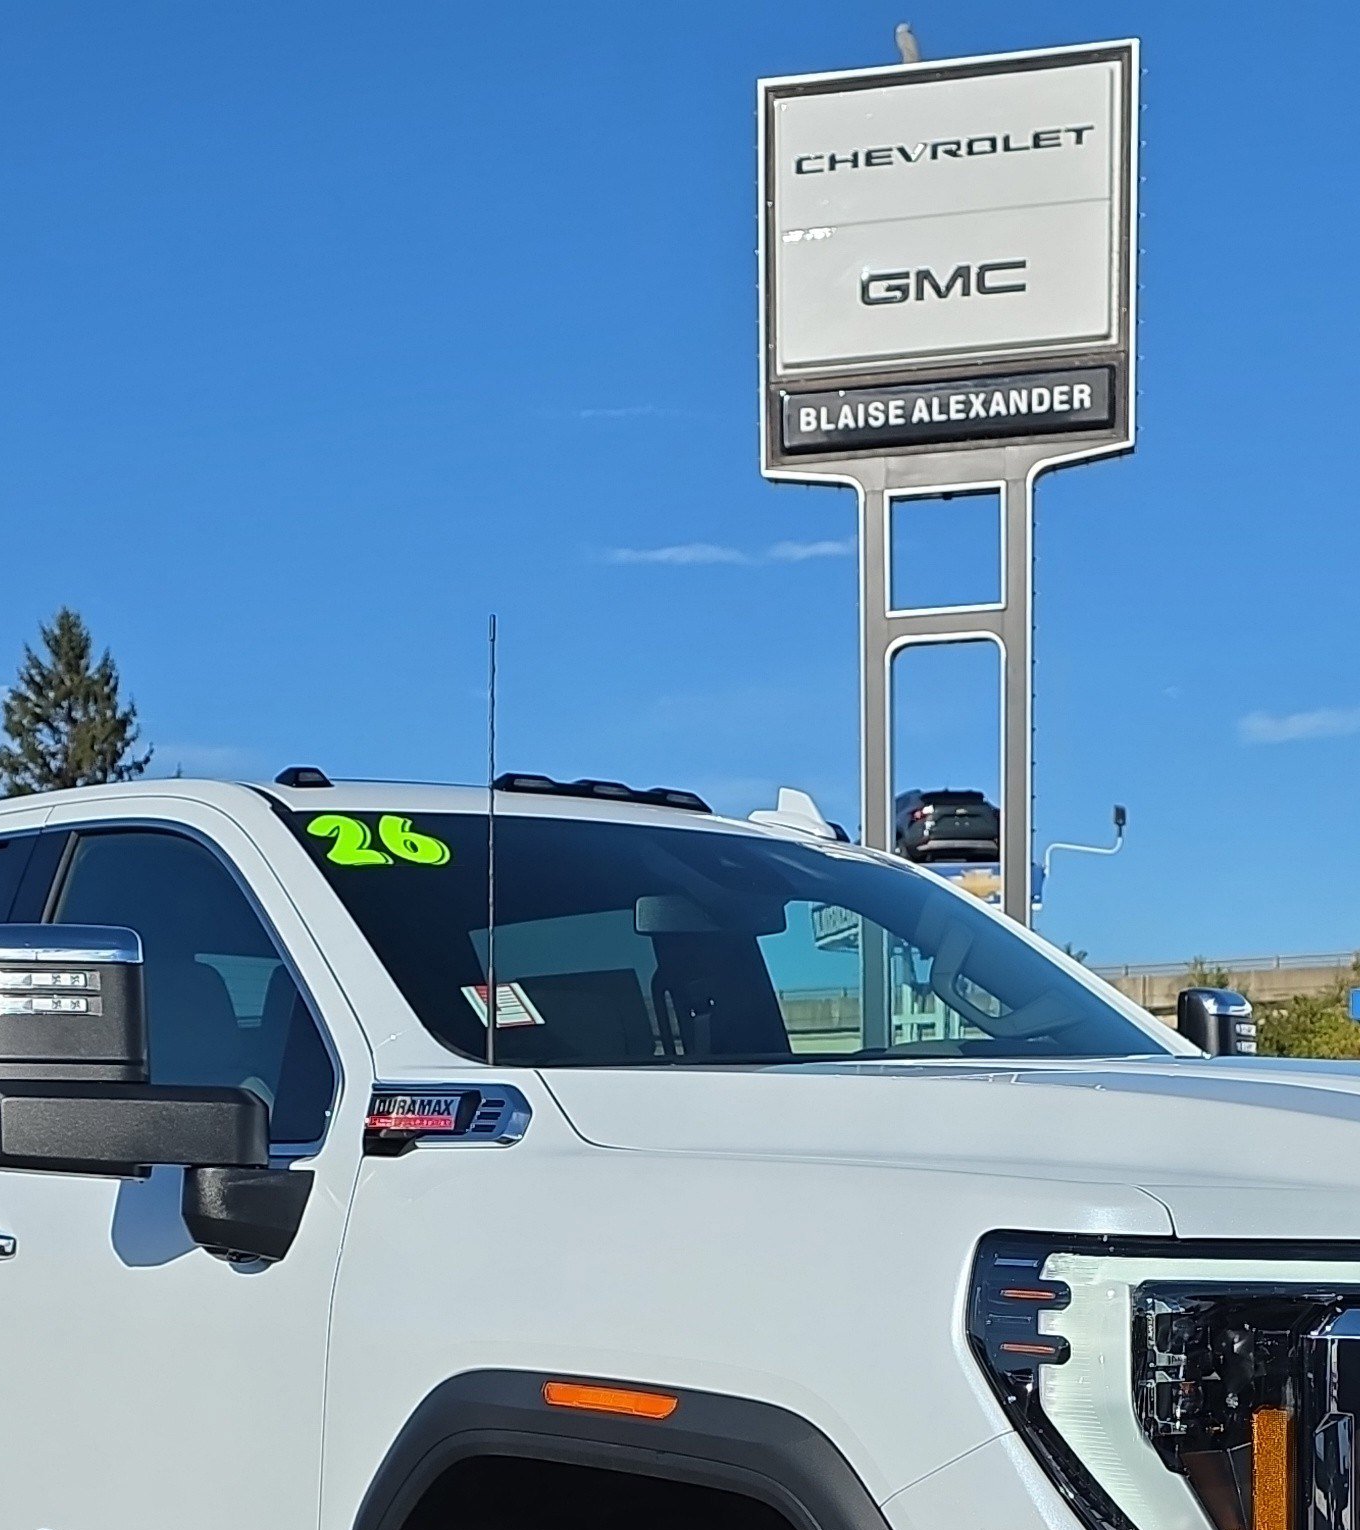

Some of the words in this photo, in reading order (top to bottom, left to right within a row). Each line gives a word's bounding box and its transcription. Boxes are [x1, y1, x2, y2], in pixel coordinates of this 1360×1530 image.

[794, 124, 1095, 175] CHEVROLET
[859, 259, 1028, 307] GMC
[798, 399, 906, 433] BLAISE
[911, 382, 1093, 424] ALEXANDER
[306, 813, 452, 867] 26
[372, 1098, 455, 1117] DURAMAX
